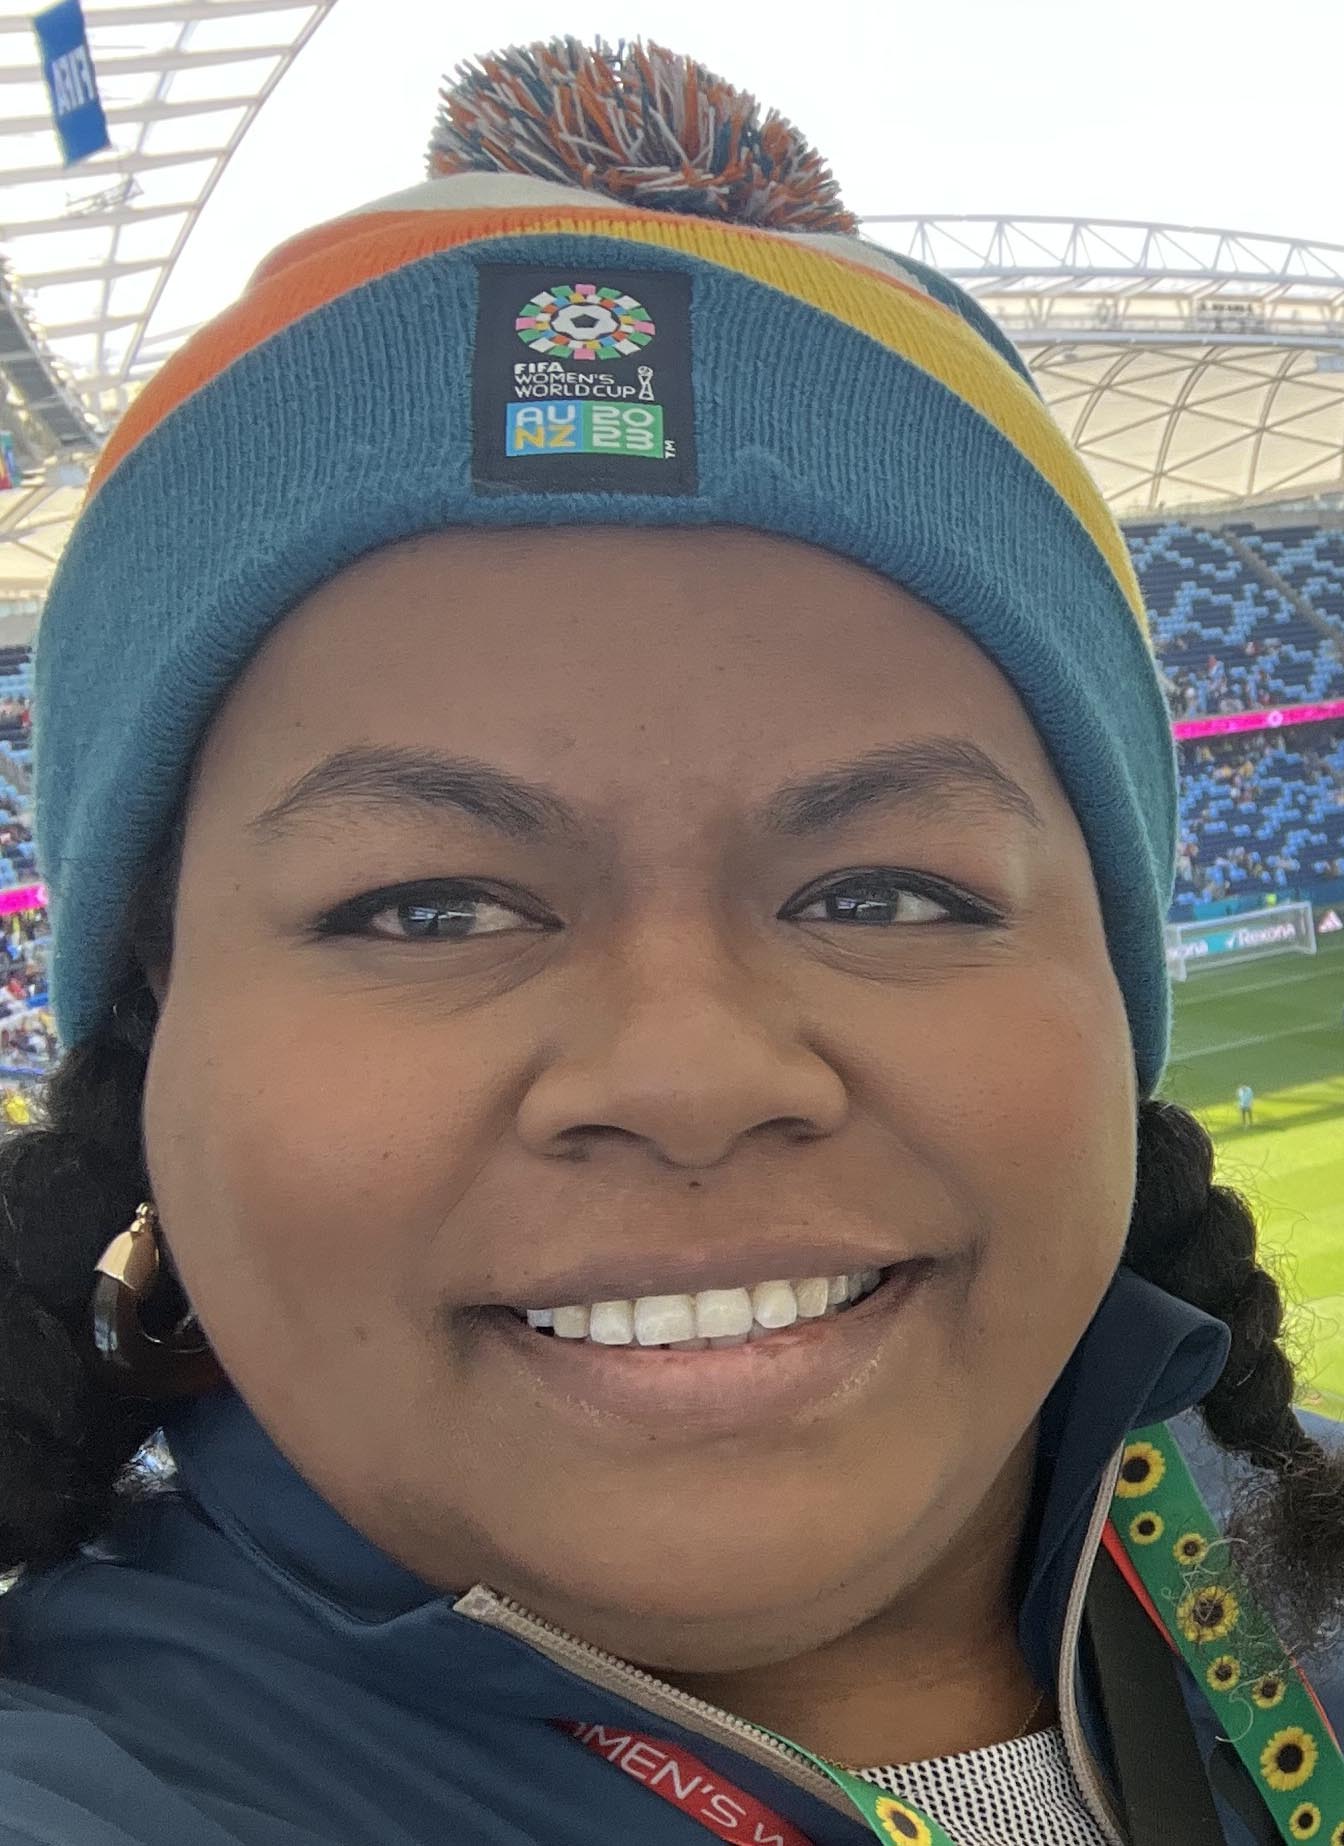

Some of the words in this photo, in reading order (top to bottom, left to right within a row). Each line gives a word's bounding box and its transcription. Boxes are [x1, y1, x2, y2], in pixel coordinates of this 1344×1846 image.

[514, 362, 564, 374] FIFA
[514, 372, 614, 385] WOMEN'S
[514, 384, 590, 398] WORLD
[592, 385, 636, 398] CUP
[516, 405, 576, 427] AU
[514, 426, 576, 450] NZ
